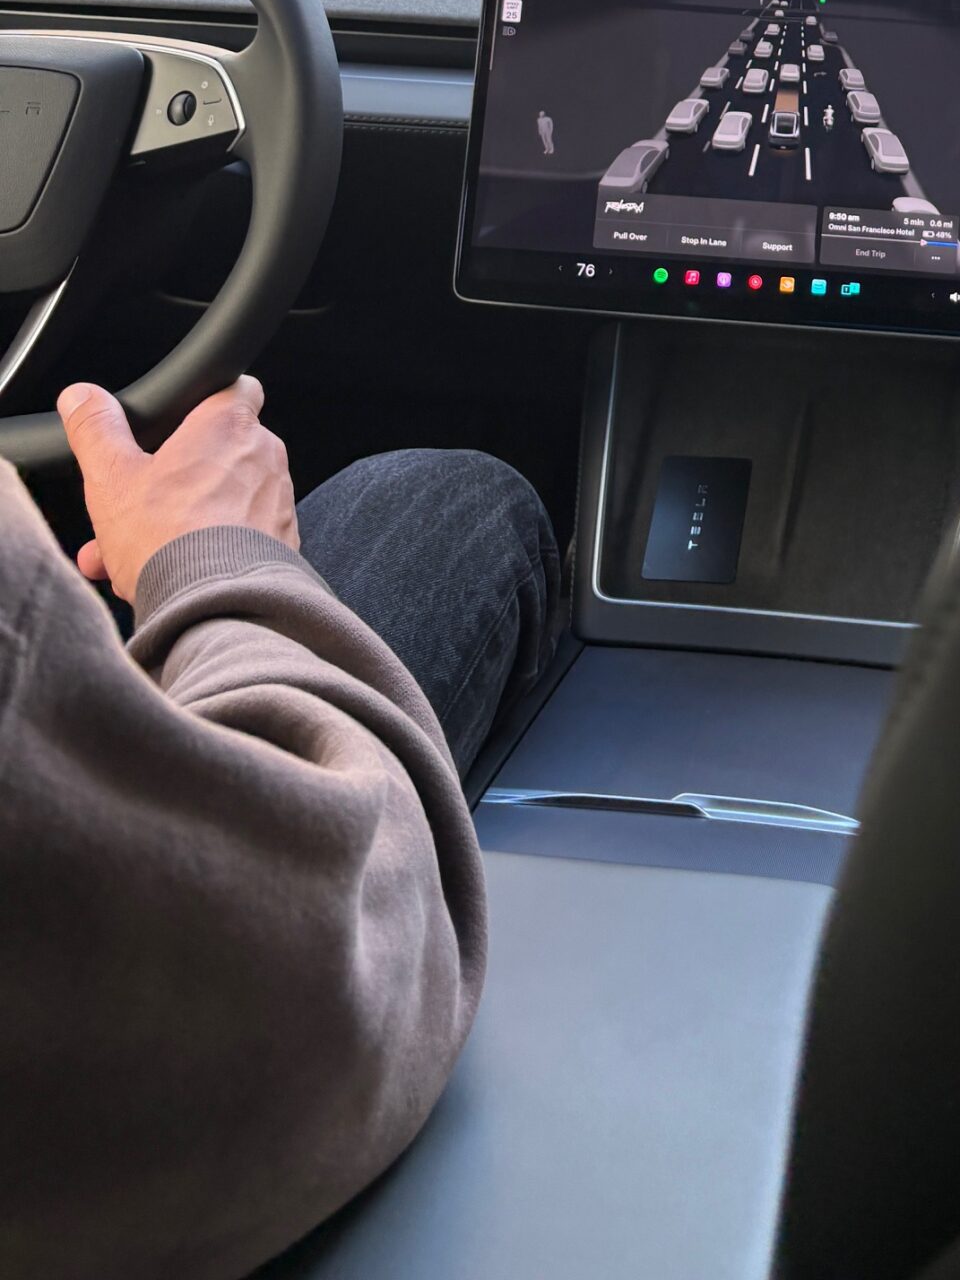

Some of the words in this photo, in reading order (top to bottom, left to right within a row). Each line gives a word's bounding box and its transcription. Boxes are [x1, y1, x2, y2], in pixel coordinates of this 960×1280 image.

[505, 11, 518, 20] 25
[847, 213, 860, 222] am
[909, 218, 925, 226] min
[943, 220, 953, 228] mi
[828, 223, 847, 231] Omni
[847, 224, 861, 232] San
[861, 225, 895, 235] Francisco
[896, 228, 915, 237] Hotel
[613, 231, 628, 240] Pull
[628, 232, 648, 241] Over
[681, 236, 700, 246] Stop
[700, 237, 708, 245] In
[709, 238, 728, 247] Lane
[762, 241, 794, 252] Support
[855, 248, 870, 257] End
[871, 249, 886, 259] Trip
[576, 262, 596, 277] 76
[687, 484, 709, 551] TESLA
